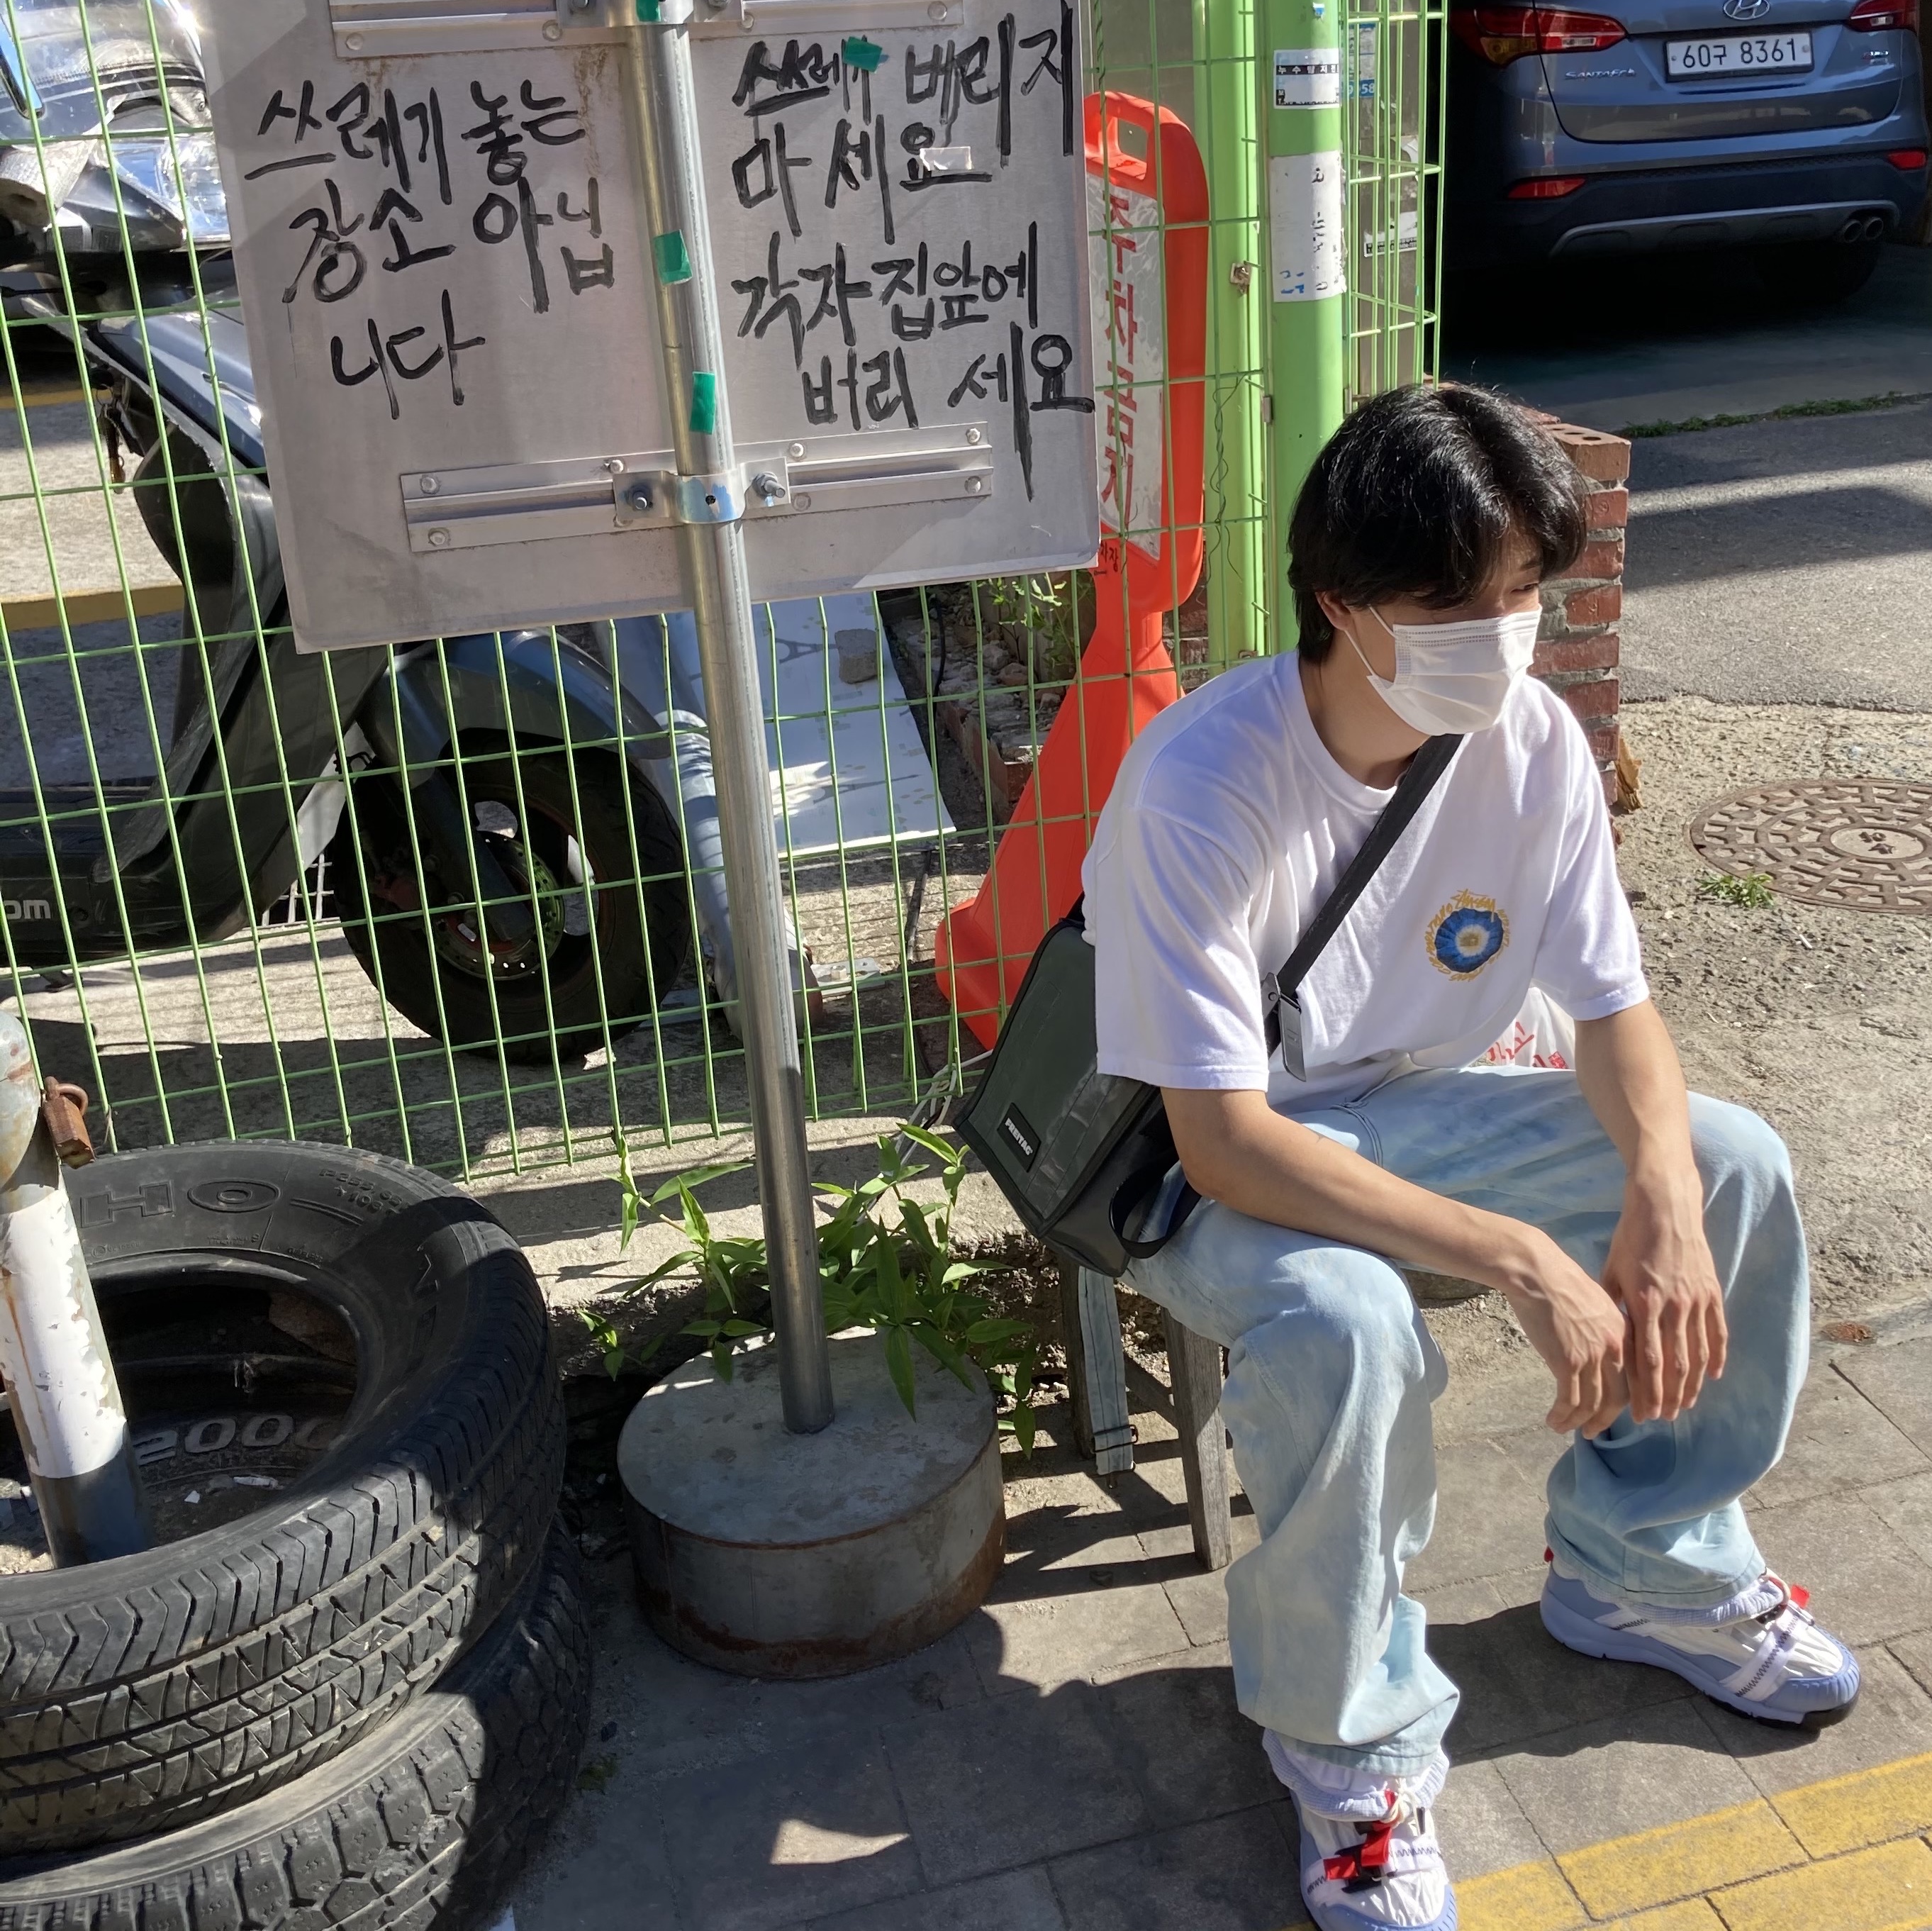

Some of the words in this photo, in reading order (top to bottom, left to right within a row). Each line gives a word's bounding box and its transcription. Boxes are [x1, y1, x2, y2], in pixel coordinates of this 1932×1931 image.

[1682, 43, 1727, 69] 60구
[1740, 37, 1797, 65] 8361
[245, 79, 453, 206] 쓰레기
[461, 79, 586, 185] 놓는
[281, 179, 457, 304] 장소
[473, 176, 615, 314] 아닙
[330, 289, 486, 420] 니다
[1005, 1117, 1033, 1156] FREITAG
